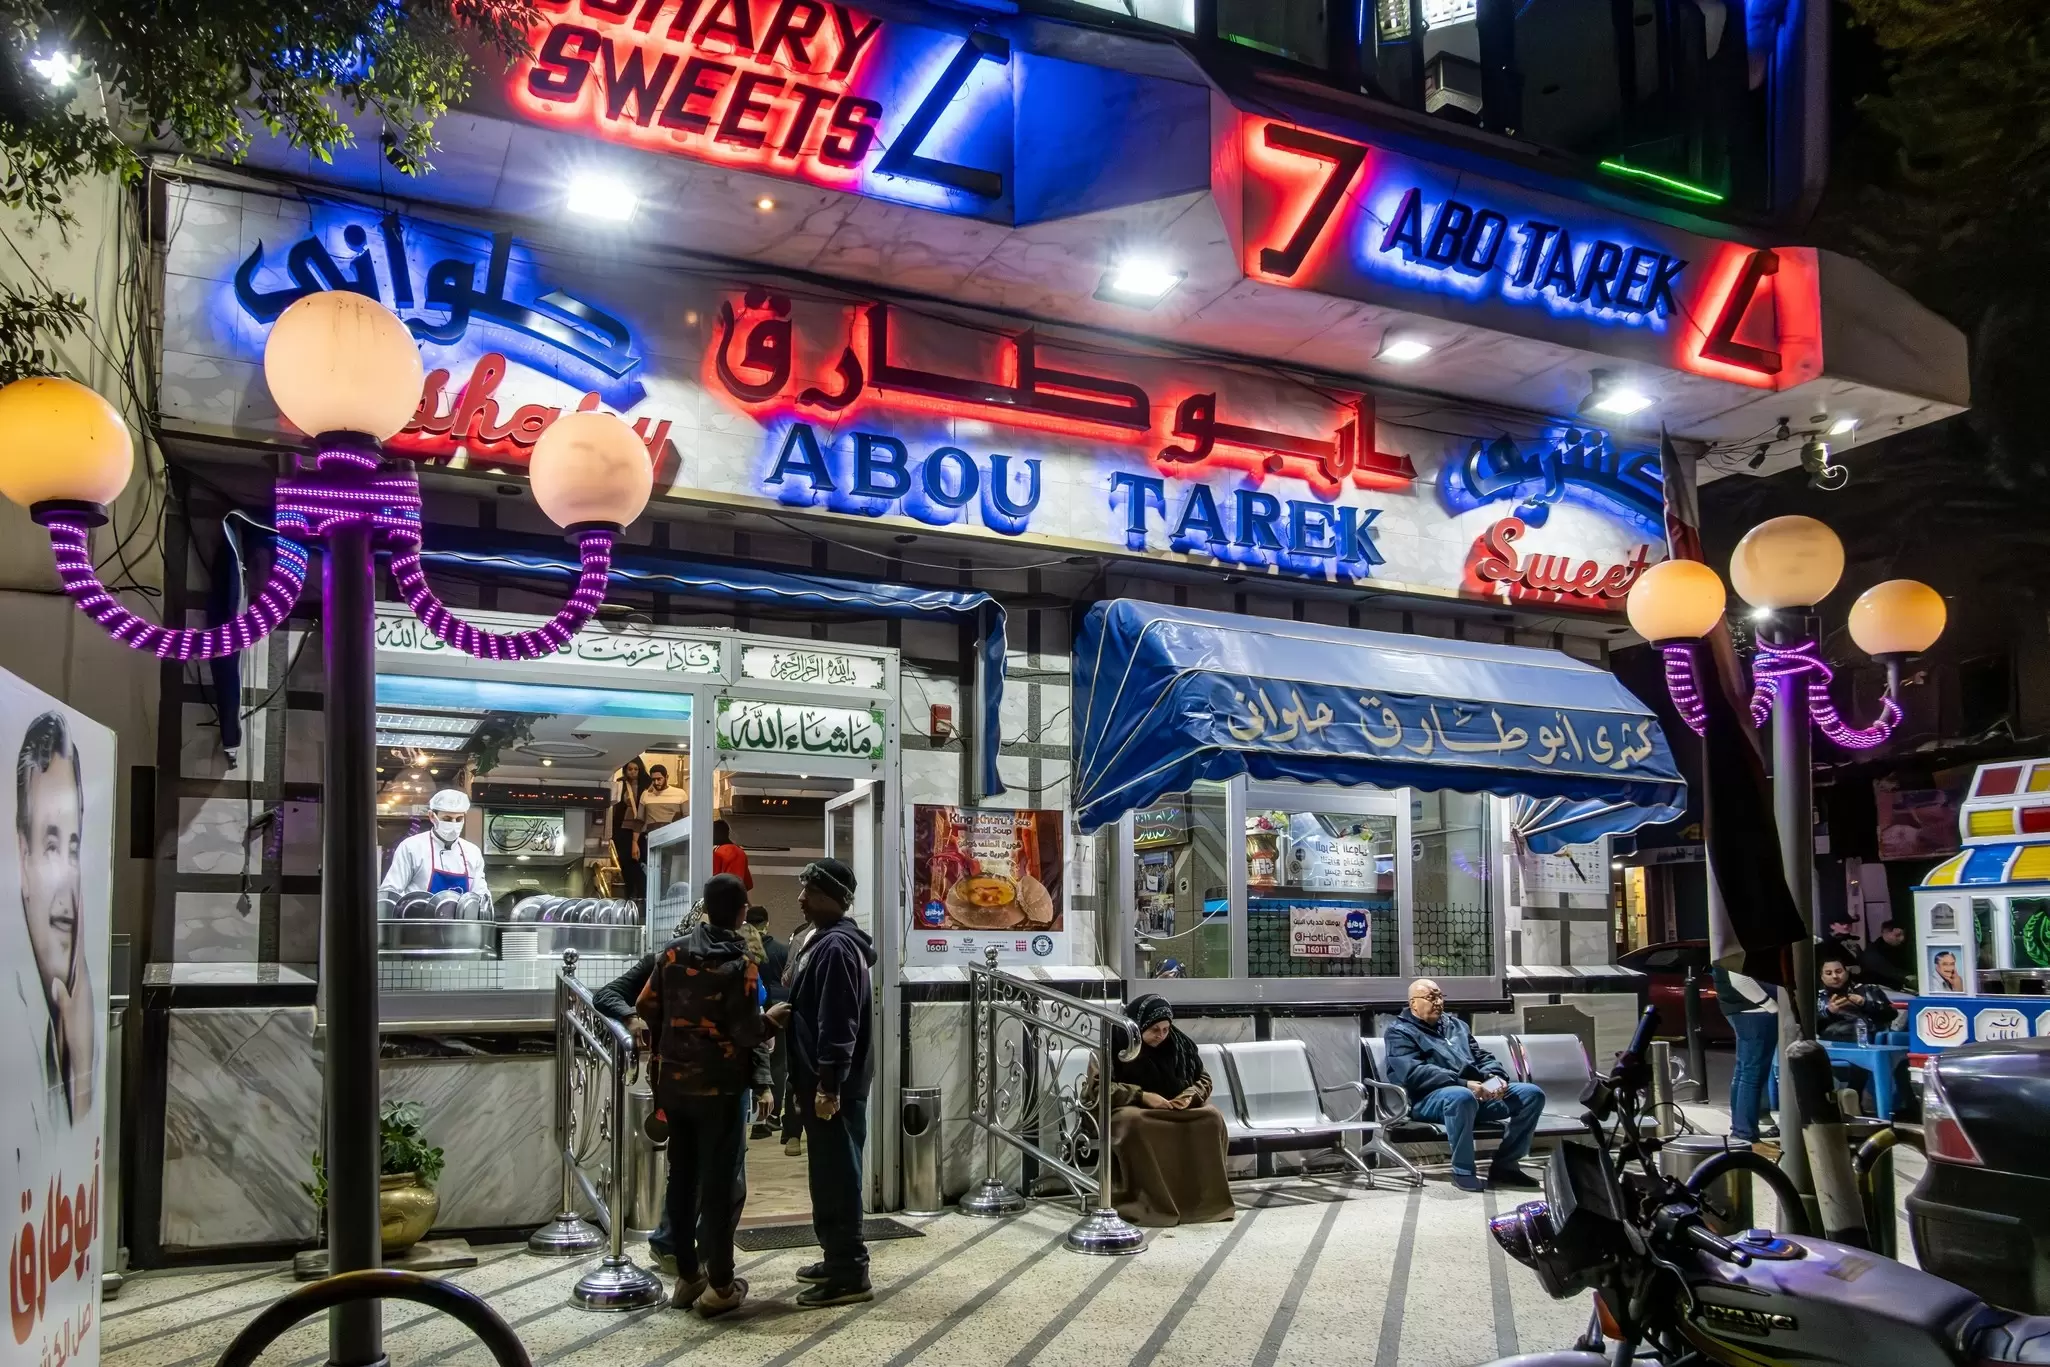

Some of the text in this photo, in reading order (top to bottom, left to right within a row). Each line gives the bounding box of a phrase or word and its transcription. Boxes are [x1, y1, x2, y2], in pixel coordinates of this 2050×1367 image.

[528, 23, 884, 170] SWEETS
[1380, 187, 1690, 318] ABO TAREK
[715, 285, 1153, 432] طارق
[763, 422, 1387, 567] ABOU TAREK
[1476, 516, 1669, 599] Sweet
[992, 827, 1012, 836] Soup
[926, 944, 949, 953] 16011
[1307, 945, 1327, 954] 16011
